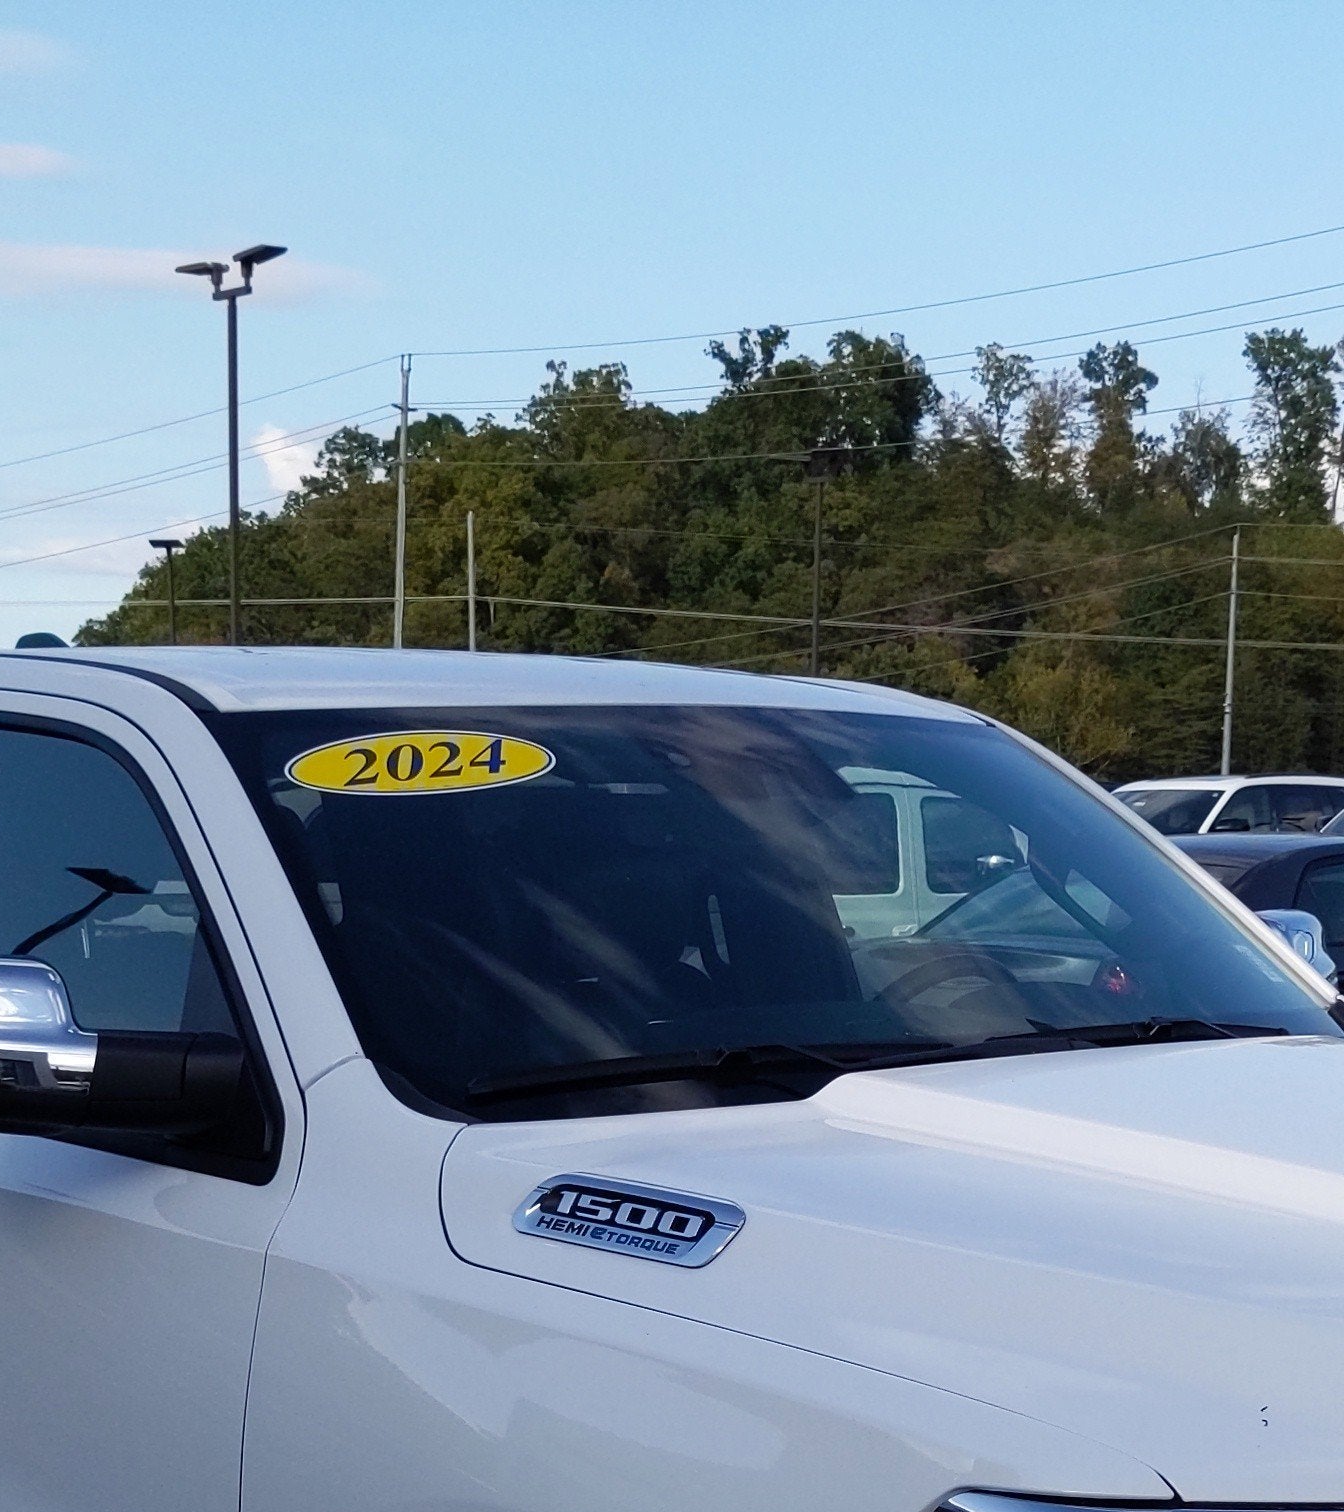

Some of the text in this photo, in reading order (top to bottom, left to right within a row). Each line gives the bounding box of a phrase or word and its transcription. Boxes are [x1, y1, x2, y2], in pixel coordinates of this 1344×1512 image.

[343, 738, 507, 786] 2024
[536, 1215, 588, 1237] HEMI
[556, 1190, 706, 1239] 1500
